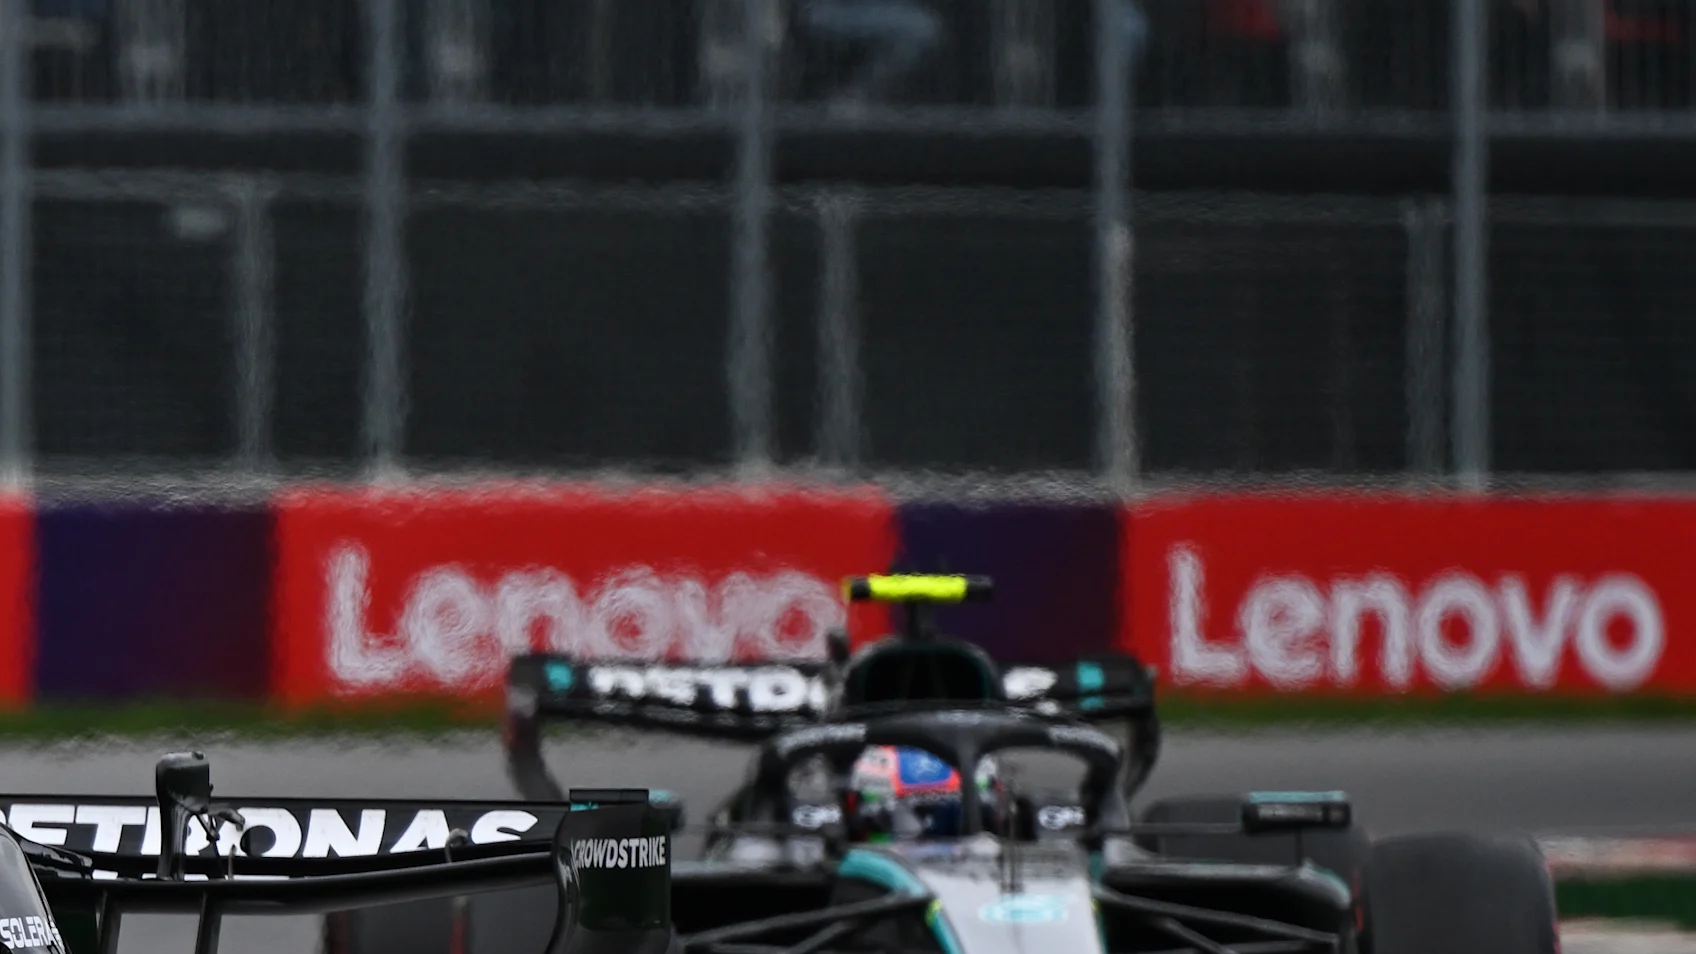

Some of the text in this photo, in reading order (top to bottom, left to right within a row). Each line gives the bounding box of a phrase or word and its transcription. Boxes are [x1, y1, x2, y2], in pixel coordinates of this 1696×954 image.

[325, 541, 846, 692] Lenovo
[1168, 541, 1665, 689] Lenovo
[574, 835, 666, 870] CROWDSTRIKE
[0, 915, 57, 949] SOLERA
